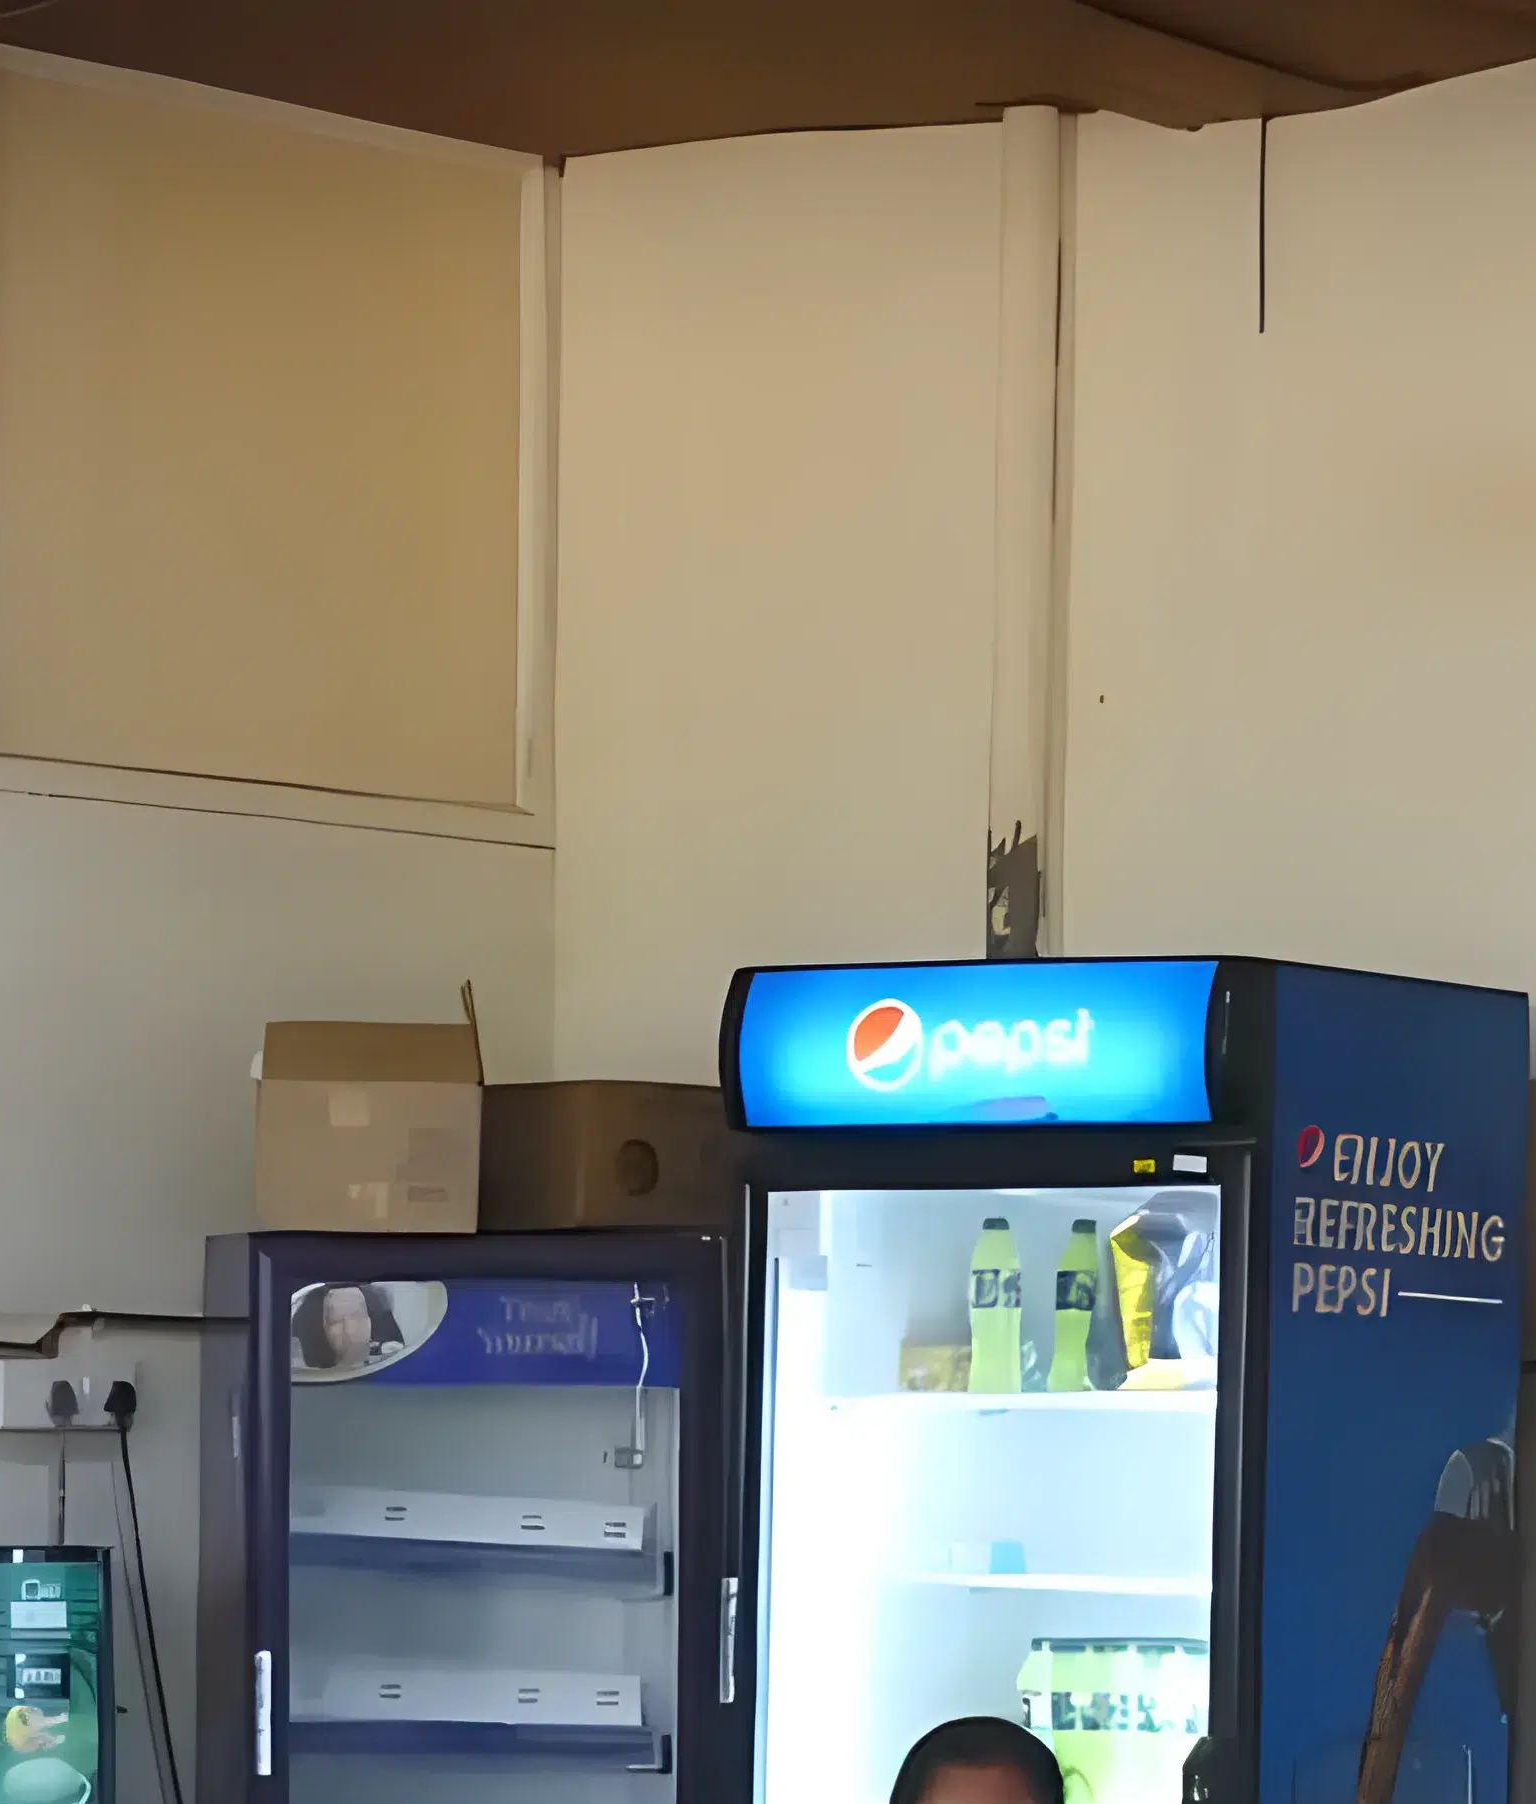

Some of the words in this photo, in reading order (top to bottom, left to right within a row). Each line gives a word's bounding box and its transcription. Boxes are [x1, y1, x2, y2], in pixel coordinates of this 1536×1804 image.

[929, 1008, 1096, 1081] pepsi
[1333, 1133, 1445, 1192] ENJOY
[1293, 1197, 1506, 1262] REFRESHING
[1291, 1262, 1391, 1317] PEPSI
